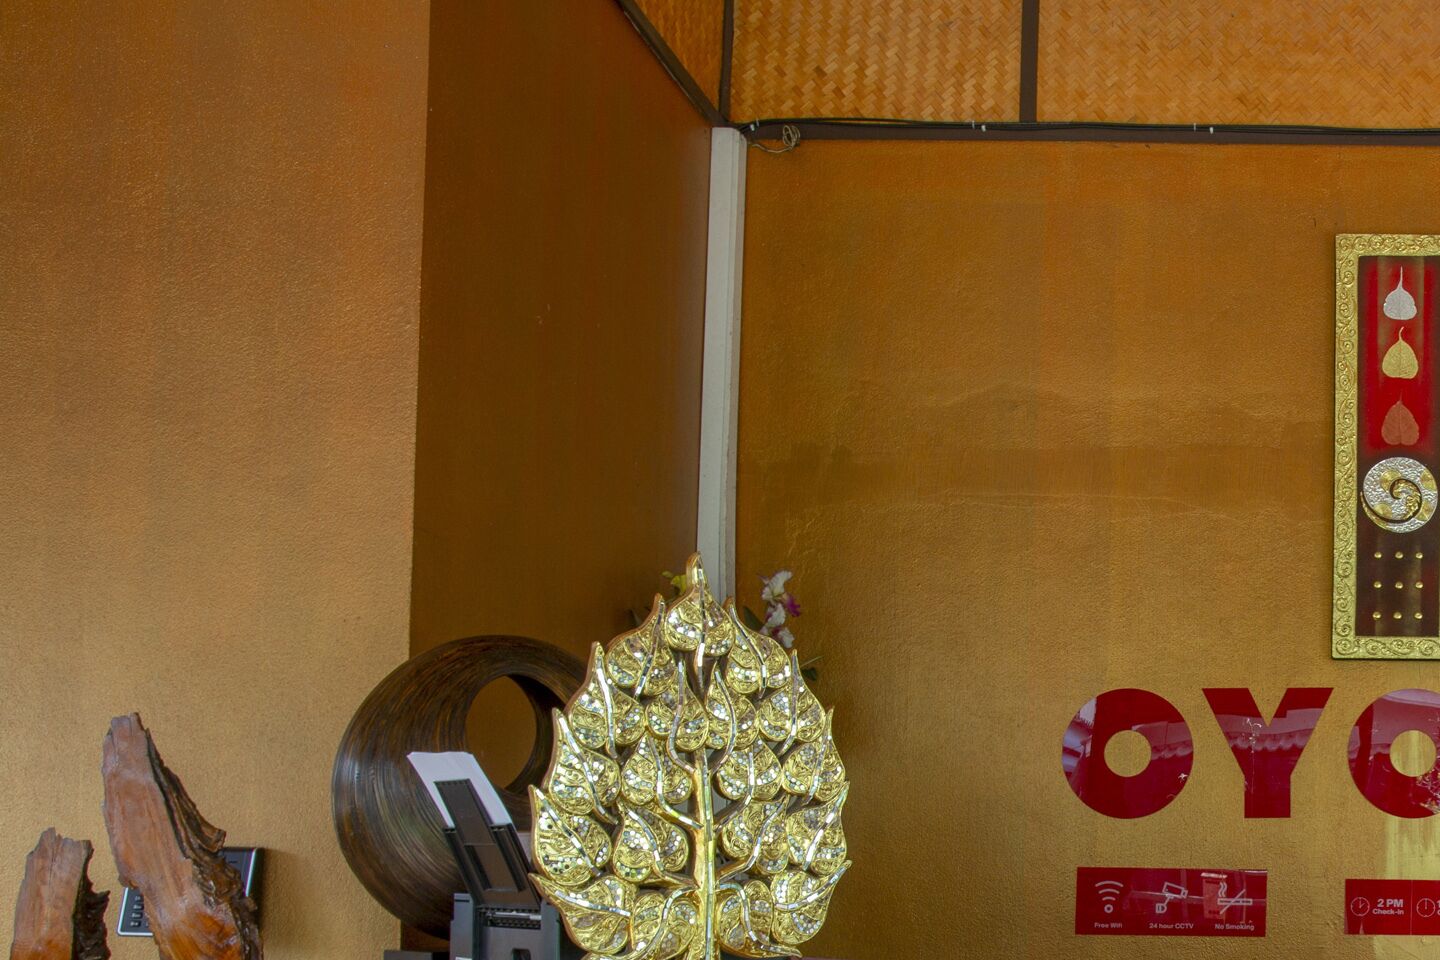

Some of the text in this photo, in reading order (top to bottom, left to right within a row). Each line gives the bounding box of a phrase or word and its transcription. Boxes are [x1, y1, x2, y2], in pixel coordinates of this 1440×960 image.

[1377, 898, 1404, 908] 2 PM
[1175, 922, 1194, 930] CCTV
